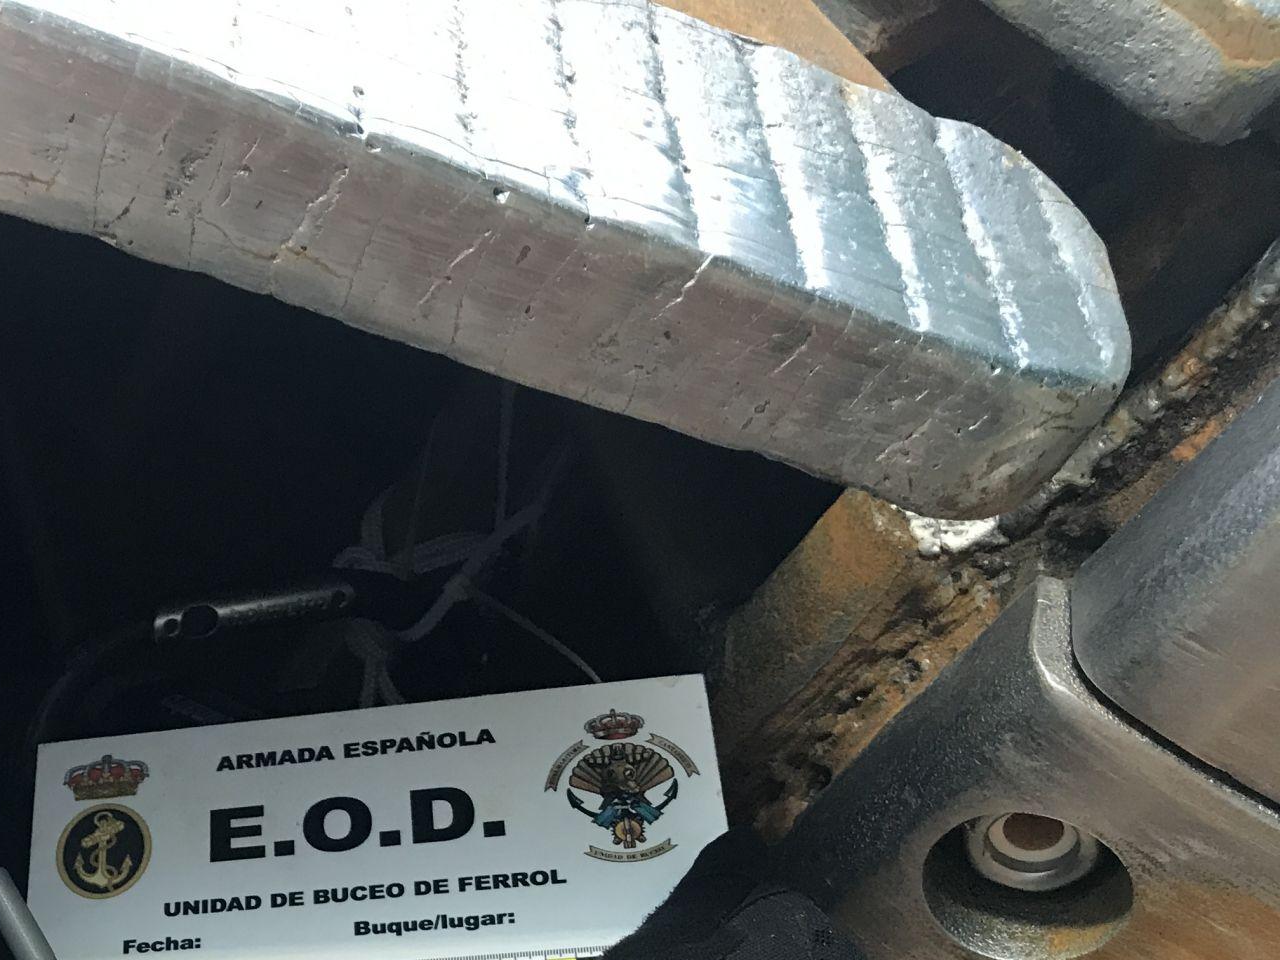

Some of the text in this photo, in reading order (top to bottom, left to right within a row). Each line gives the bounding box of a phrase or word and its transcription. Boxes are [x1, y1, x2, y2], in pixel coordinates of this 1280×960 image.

[216, 728, 496, 771] ARMADA ESPAÑOLA
[209, 786, 506, 862] E.O.D.
[164, 869, 567, 917] UNIDAD DE BUCEO DE FERROL
[122, 936, 202, 954] Fecha:
[353, 912, 516, 936] Buque/lugar:
